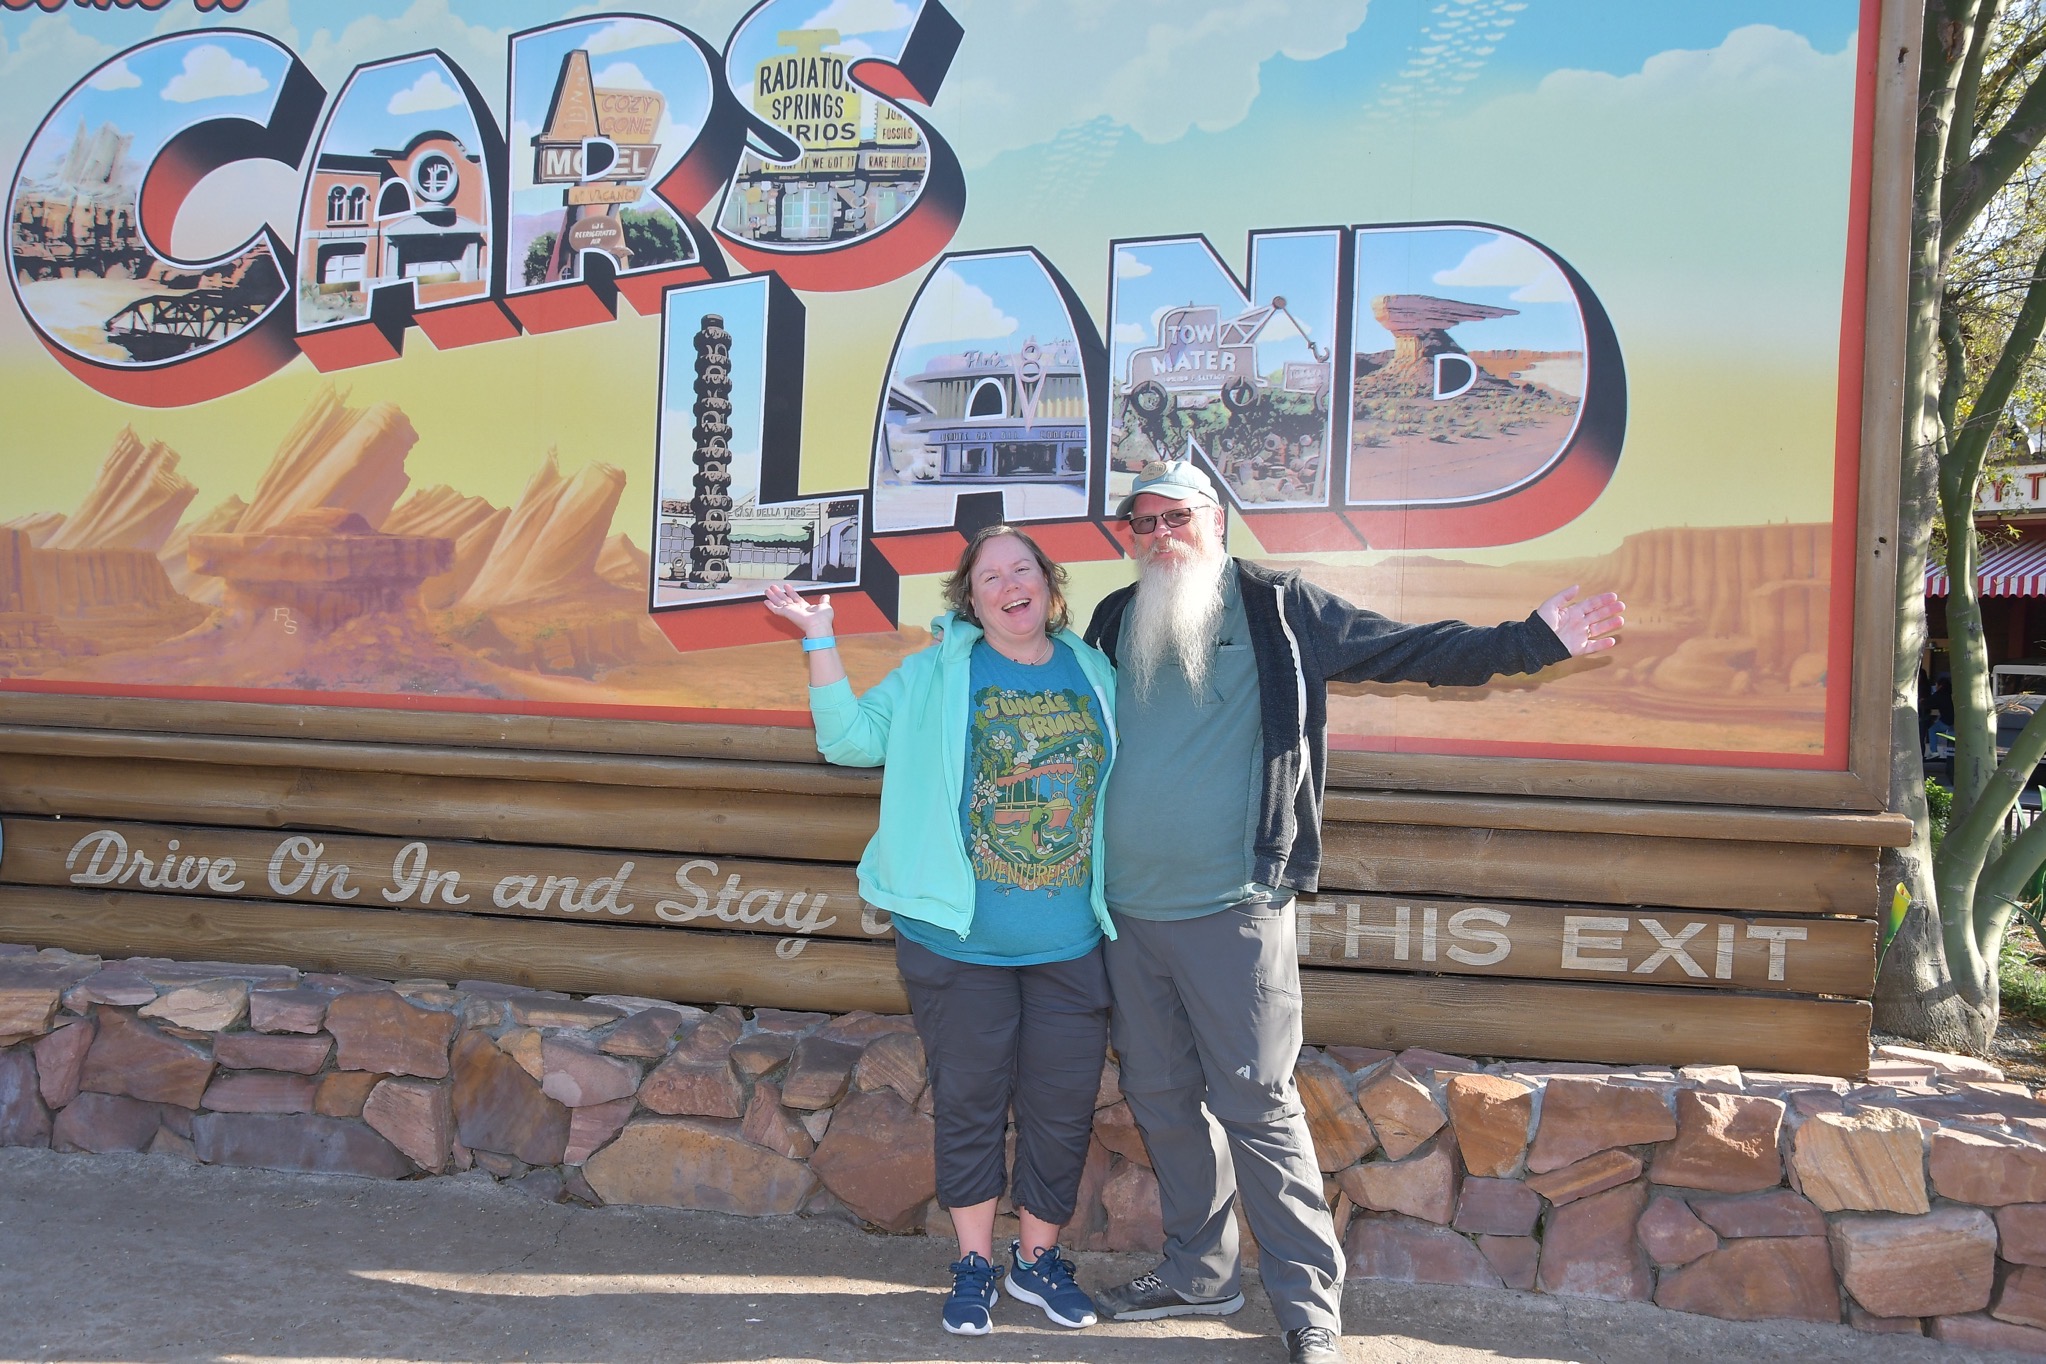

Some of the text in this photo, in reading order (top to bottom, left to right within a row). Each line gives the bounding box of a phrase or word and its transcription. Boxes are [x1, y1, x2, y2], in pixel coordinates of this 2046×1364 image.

[601, 94, 654, 114] COZY
[772, 93, 844, 120] SPRINGS
[600, 116, 653, 135] CONE
[786, 122, 856, 142] RIOS
[882, 127, 913, 141] FOSSILS
[812, 157, 824, 169] WE
[827, 156, 844, 169] GOT
[846, 156, 855, 168] IT
[868, 156, 888, 169] RARE
[6, 0, 966, 406] CARS
[1167, 323, 1216, 345] TOW
[1150, 350, 1238, 377] MATER
[648, 222, 1629, 652] LAND
[983, 694, 1071, 720] JUNGLE
[1018, 710, 1098, 740] CRUISE
[65, 830, 246, 892] Drive
[267, 835, 360, 900] On
[382, 841, 470, 905] In
[493, 860, 634, 916] and
[655, 859, 837, 960] Stay
[1560, 914, 1808, 982] EXIT
